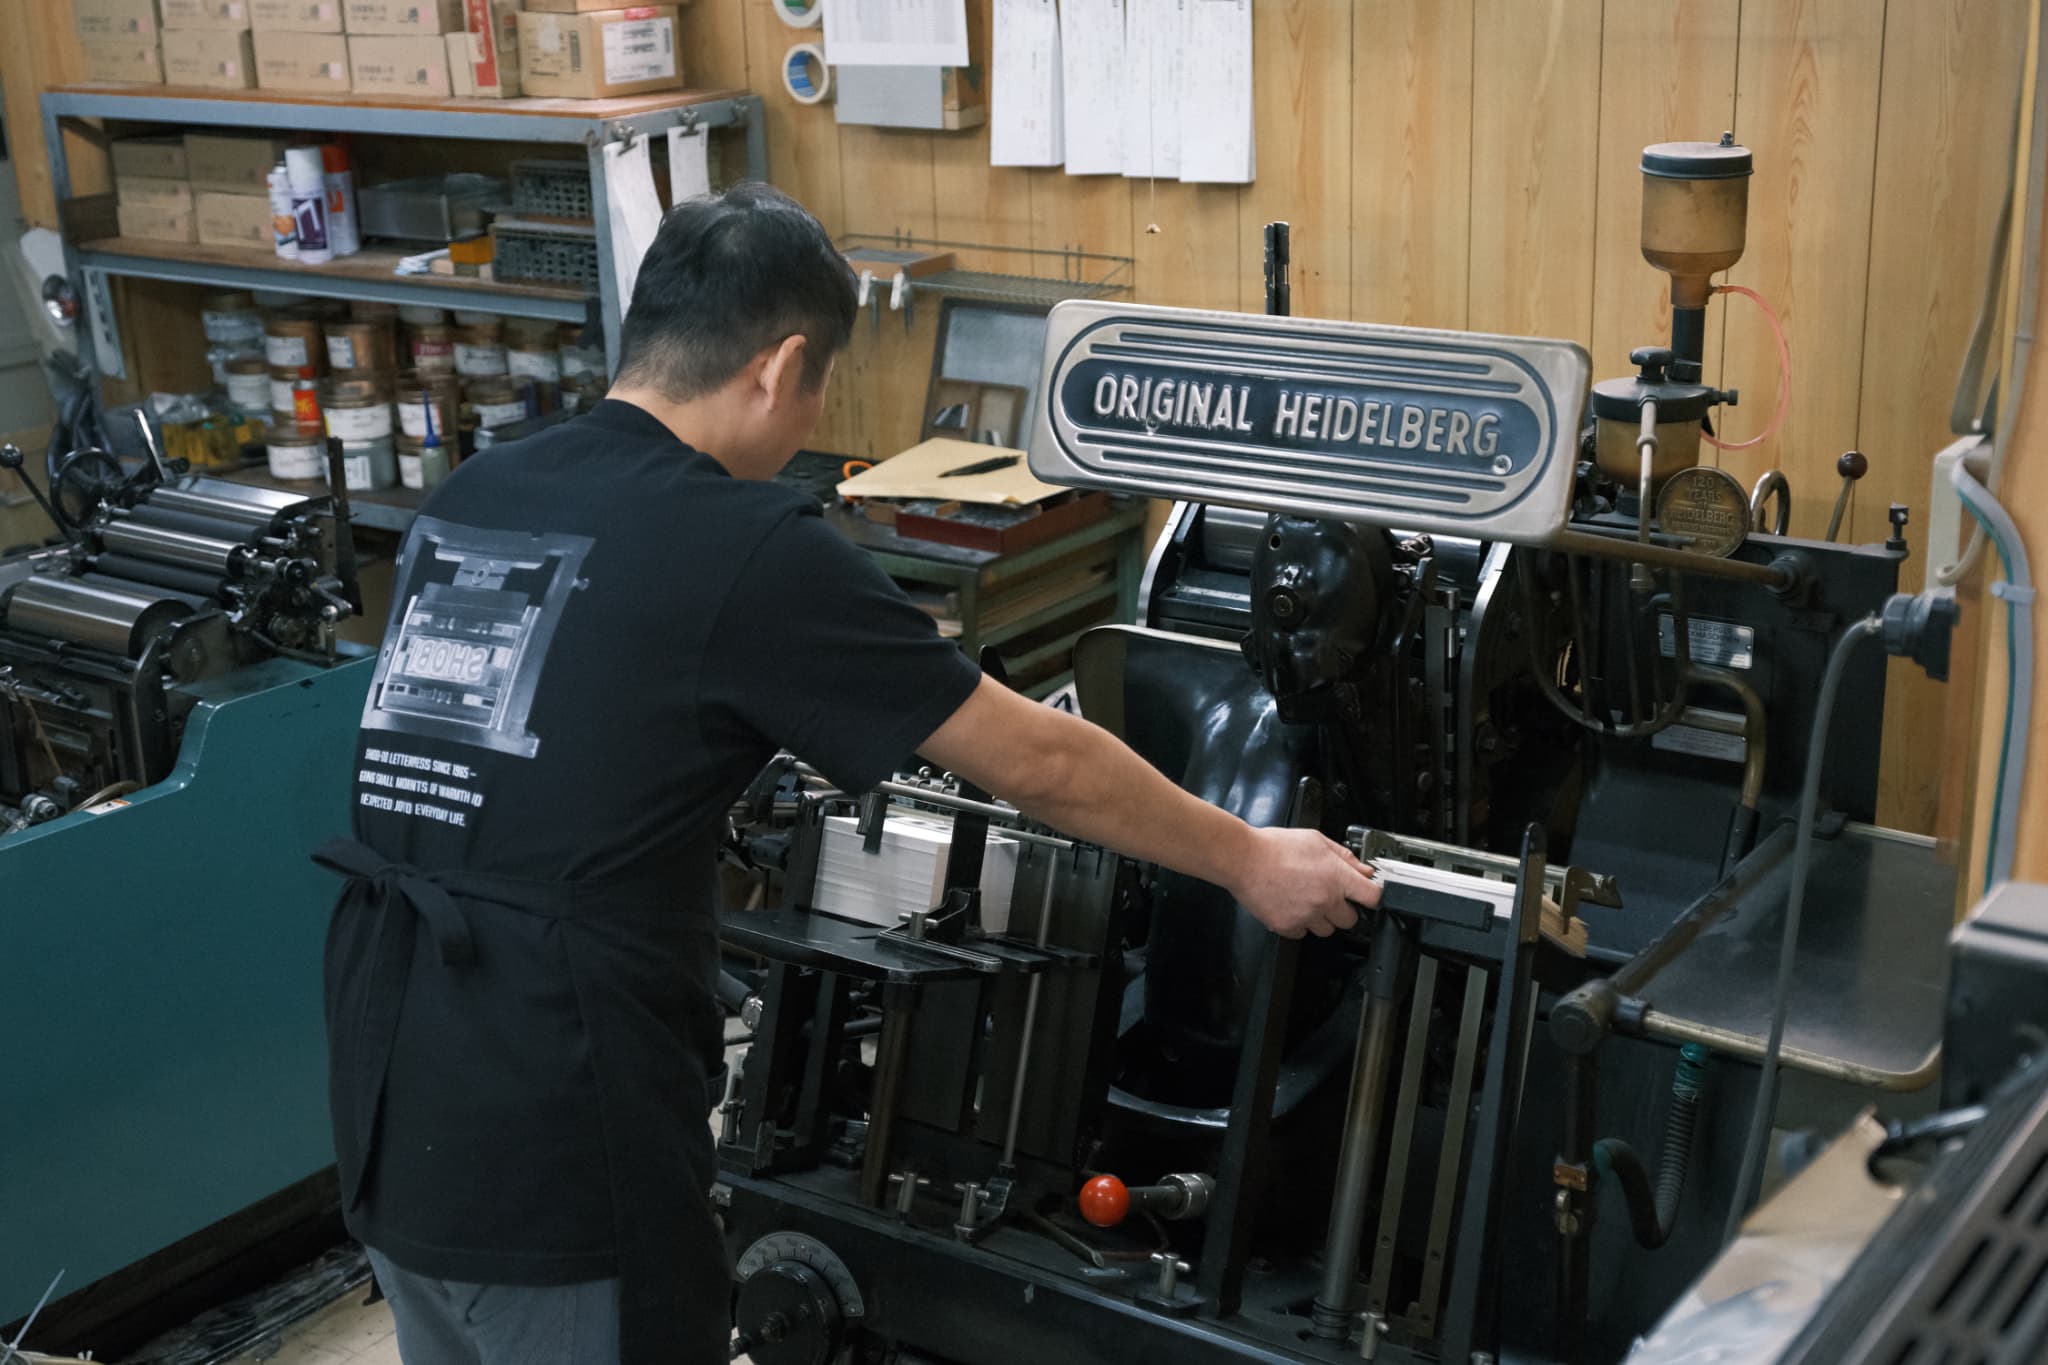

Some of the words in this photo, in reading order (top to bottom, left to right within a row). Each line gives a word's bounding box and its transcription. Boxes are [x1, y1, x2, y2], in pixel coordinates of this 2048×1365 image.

[1093, 374, 1253, 432] ORIGINAL
[1274, 392, 1500, 457] HEIDELBERG
[1694, 475, 1715, 488] 120
[1687, 487, 1721, 502] YEARS
[1671, 508, 1735, 526] HEIDELBERG
[415, 803, 449, 822] EVERYDAY
